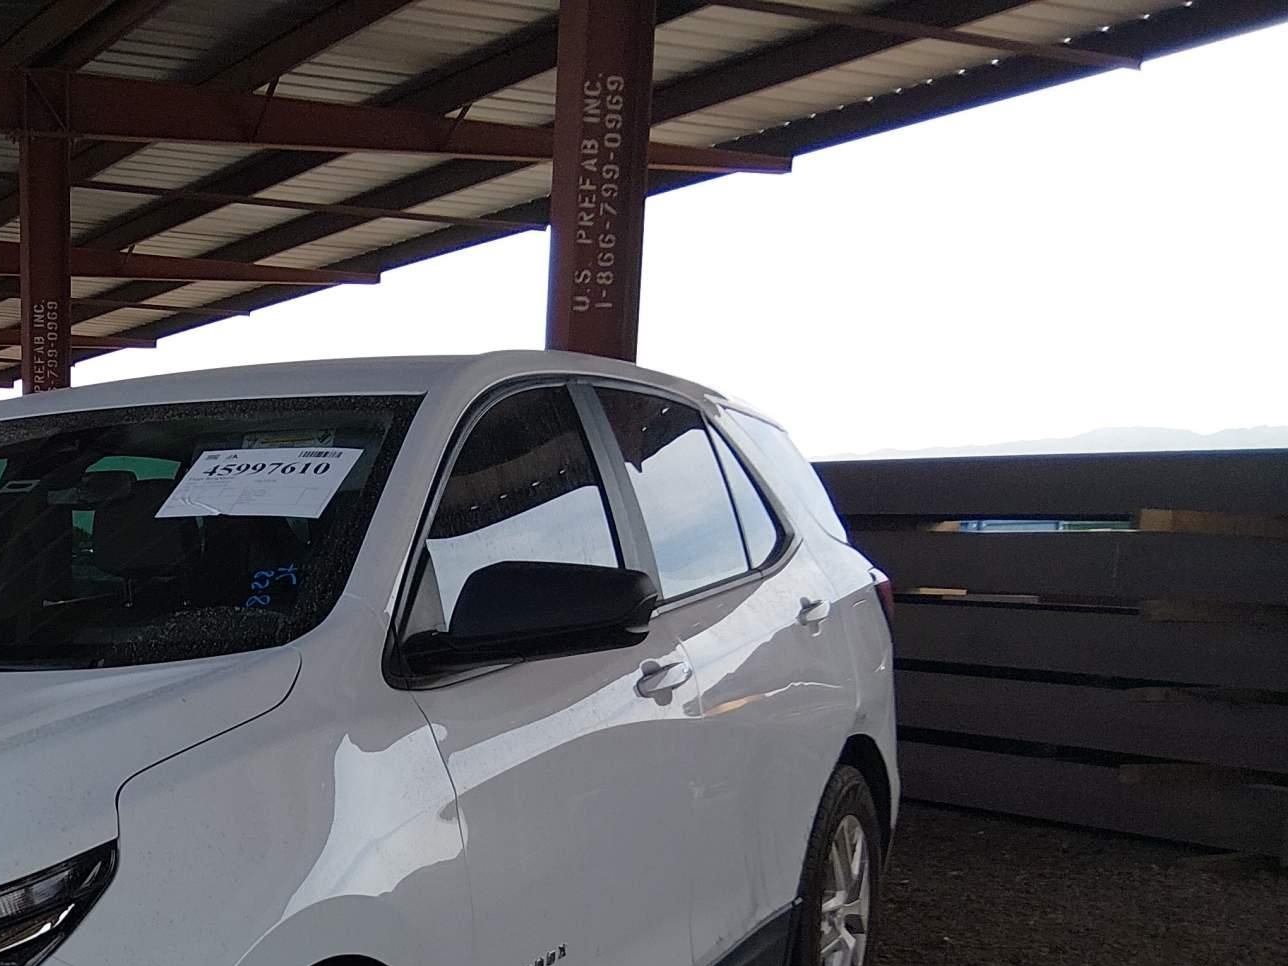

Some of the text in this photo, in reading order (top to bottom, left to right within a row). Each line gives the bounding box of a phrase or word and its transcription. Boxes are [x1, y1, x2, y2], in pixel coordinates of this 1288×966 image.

[573, 72, 603, 312] U.S. PREFAB INC.
[595, 75, 625, 310] 1-866-799-0969
[33, 298, 45, 392] PREFAB INC.
[202, 461, 331, 477] 45997610
